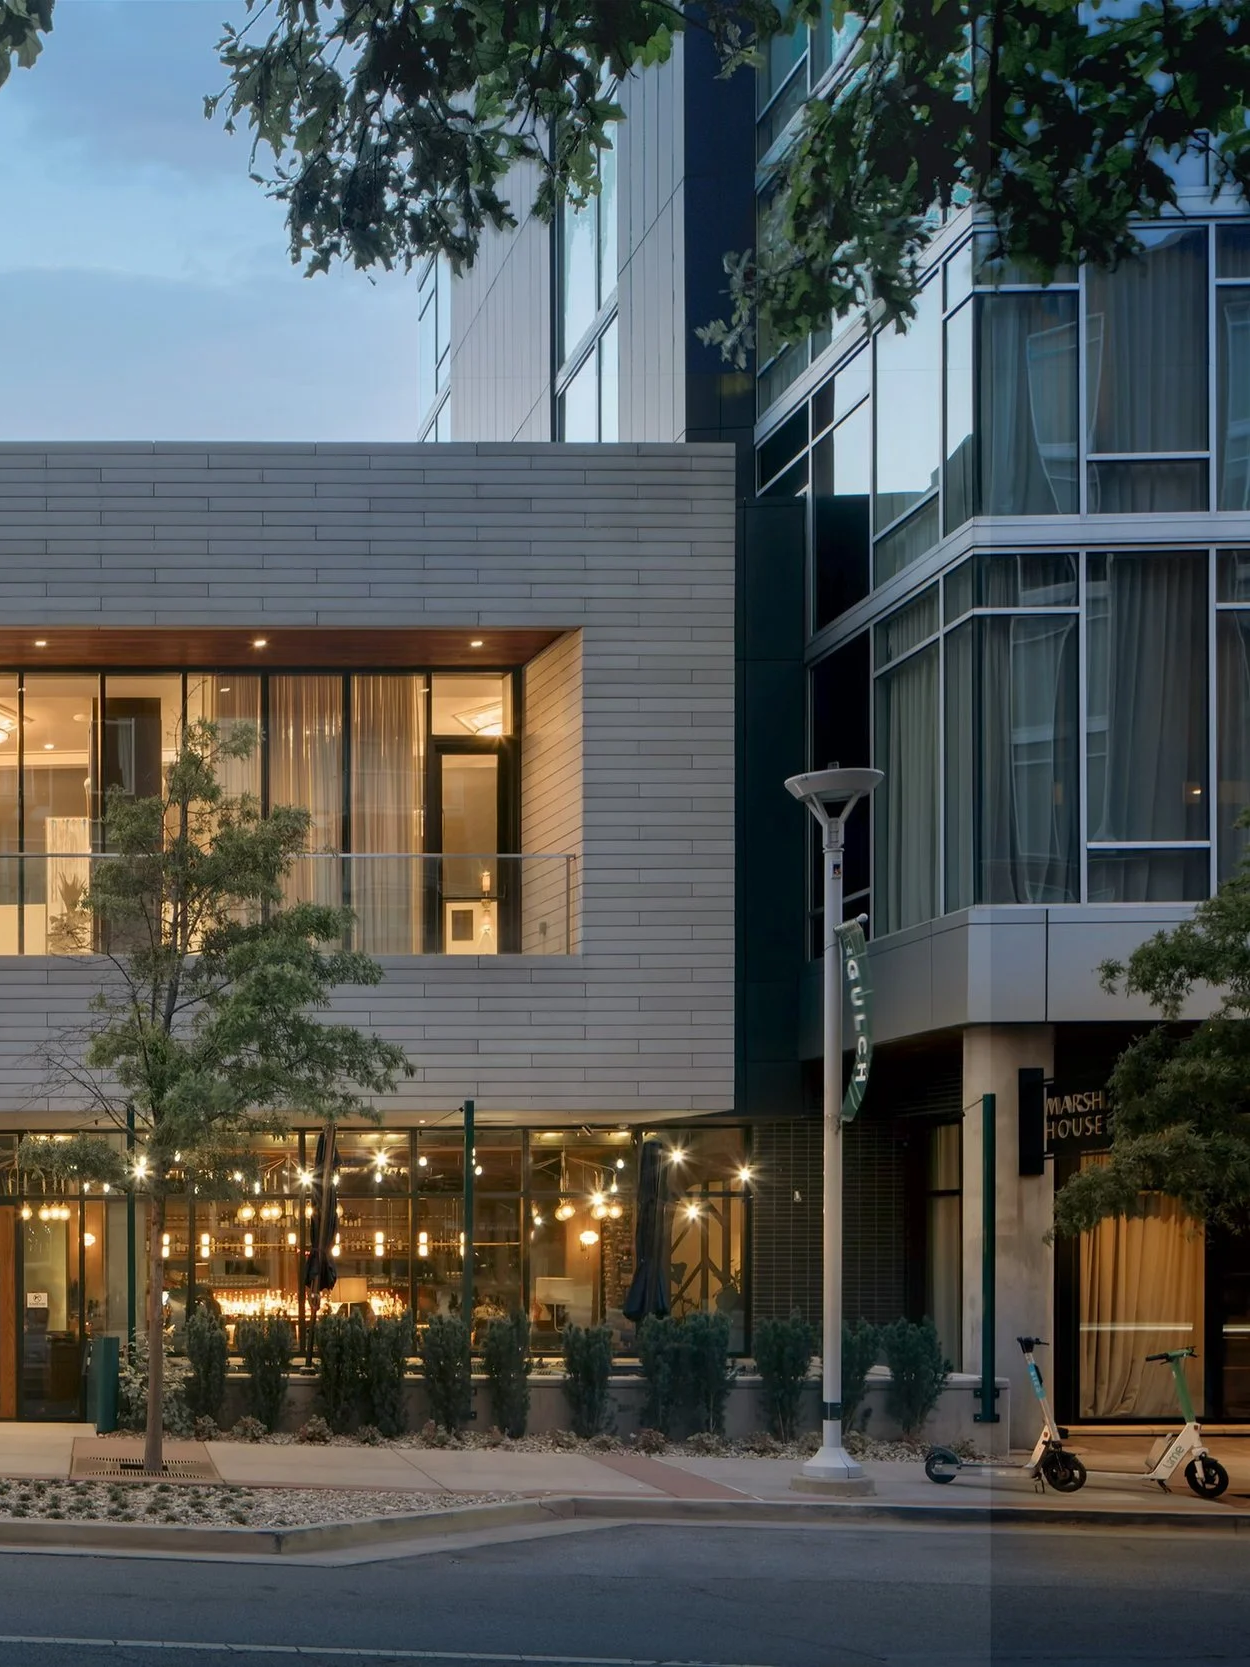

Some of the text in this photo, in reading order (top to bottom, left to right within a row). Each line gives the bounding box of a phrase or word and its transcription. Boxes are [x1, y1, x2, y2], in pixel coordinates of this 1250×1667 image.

[847, 960, 866, 1081] GULCH
[1047, 1091, 1102, 1115] MARSH
[1046, 1115, 1103, 1139] HOUSE
